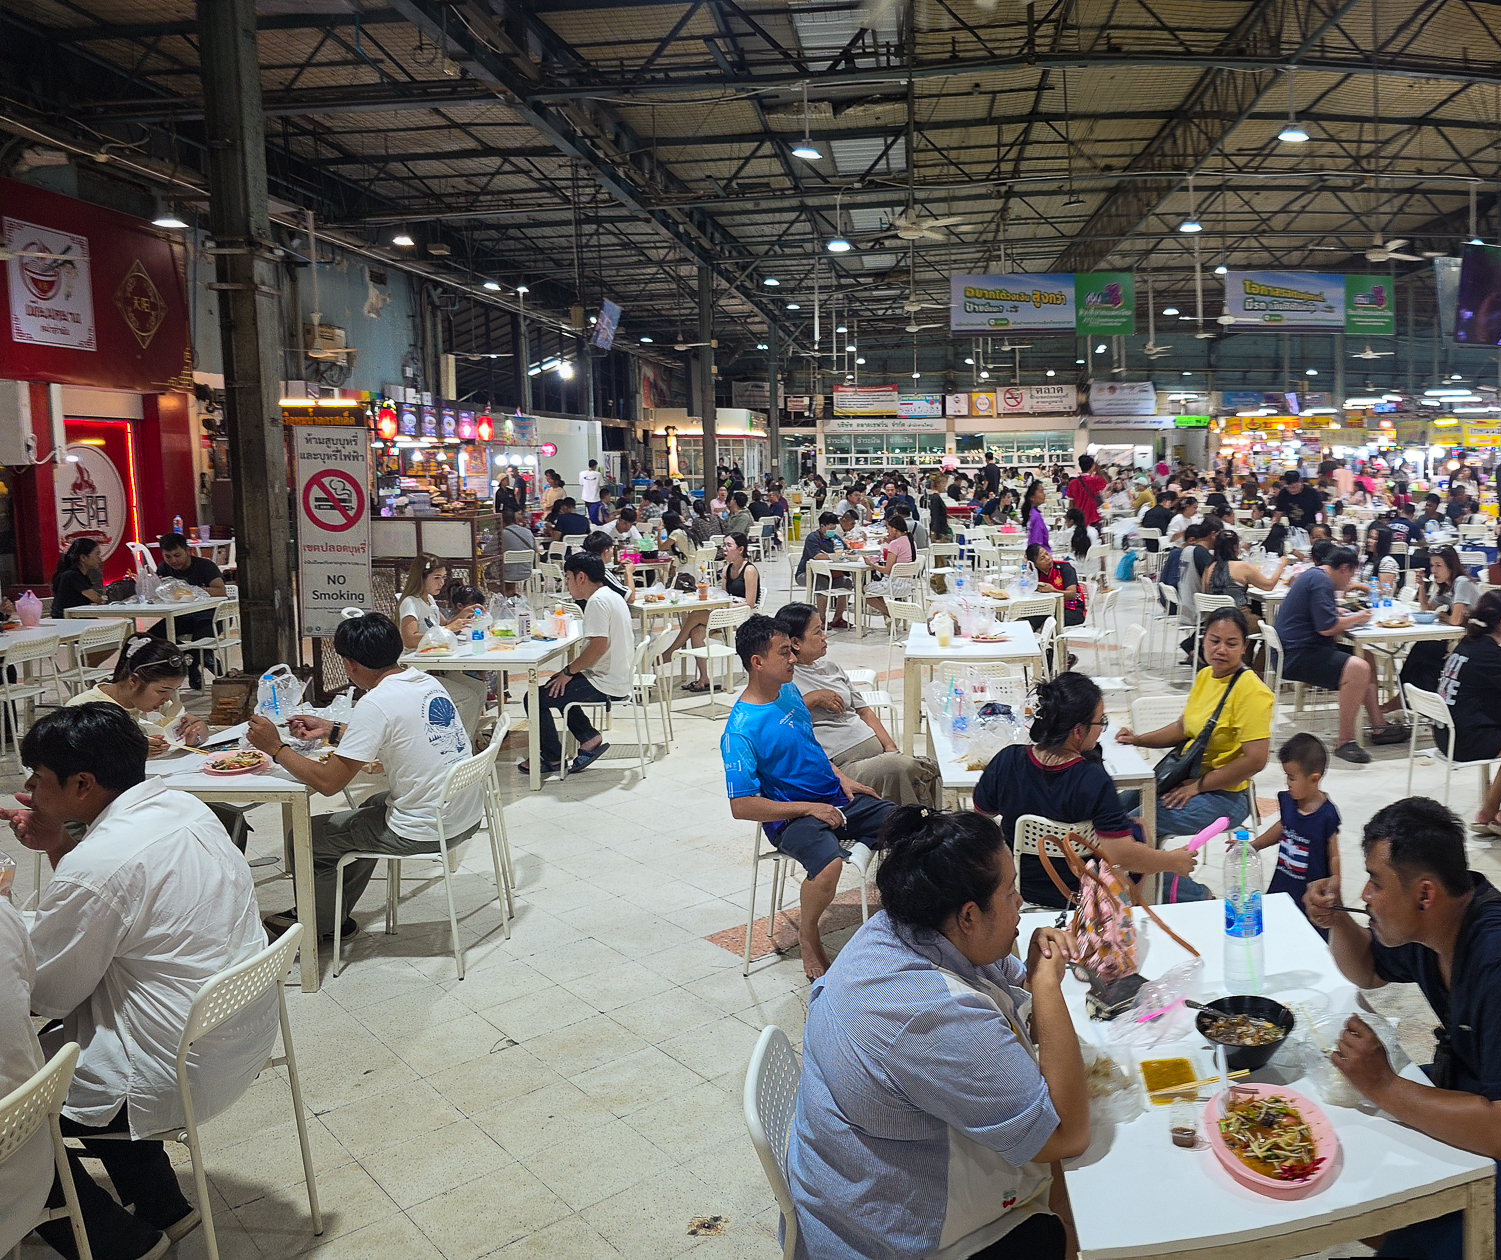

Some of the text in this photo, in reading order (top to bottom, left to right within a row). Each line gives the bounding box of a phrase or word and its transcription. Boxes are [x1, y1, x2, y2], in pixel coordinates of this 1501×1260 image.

[1035, 386, 1063, 394] ตลาด
[304, 432, 359, 449] ห้ามสูบบุหรี่
[300, 447, 365, 464] และบุหรี่ไฟฟ้า
[61, 495, 109, 530] 天阳
[303, 540, 366, 556] เขตปลอดบุหรี่
[327, 575, 346, 585] NO
[312, 590, 364, 603] Smoking
